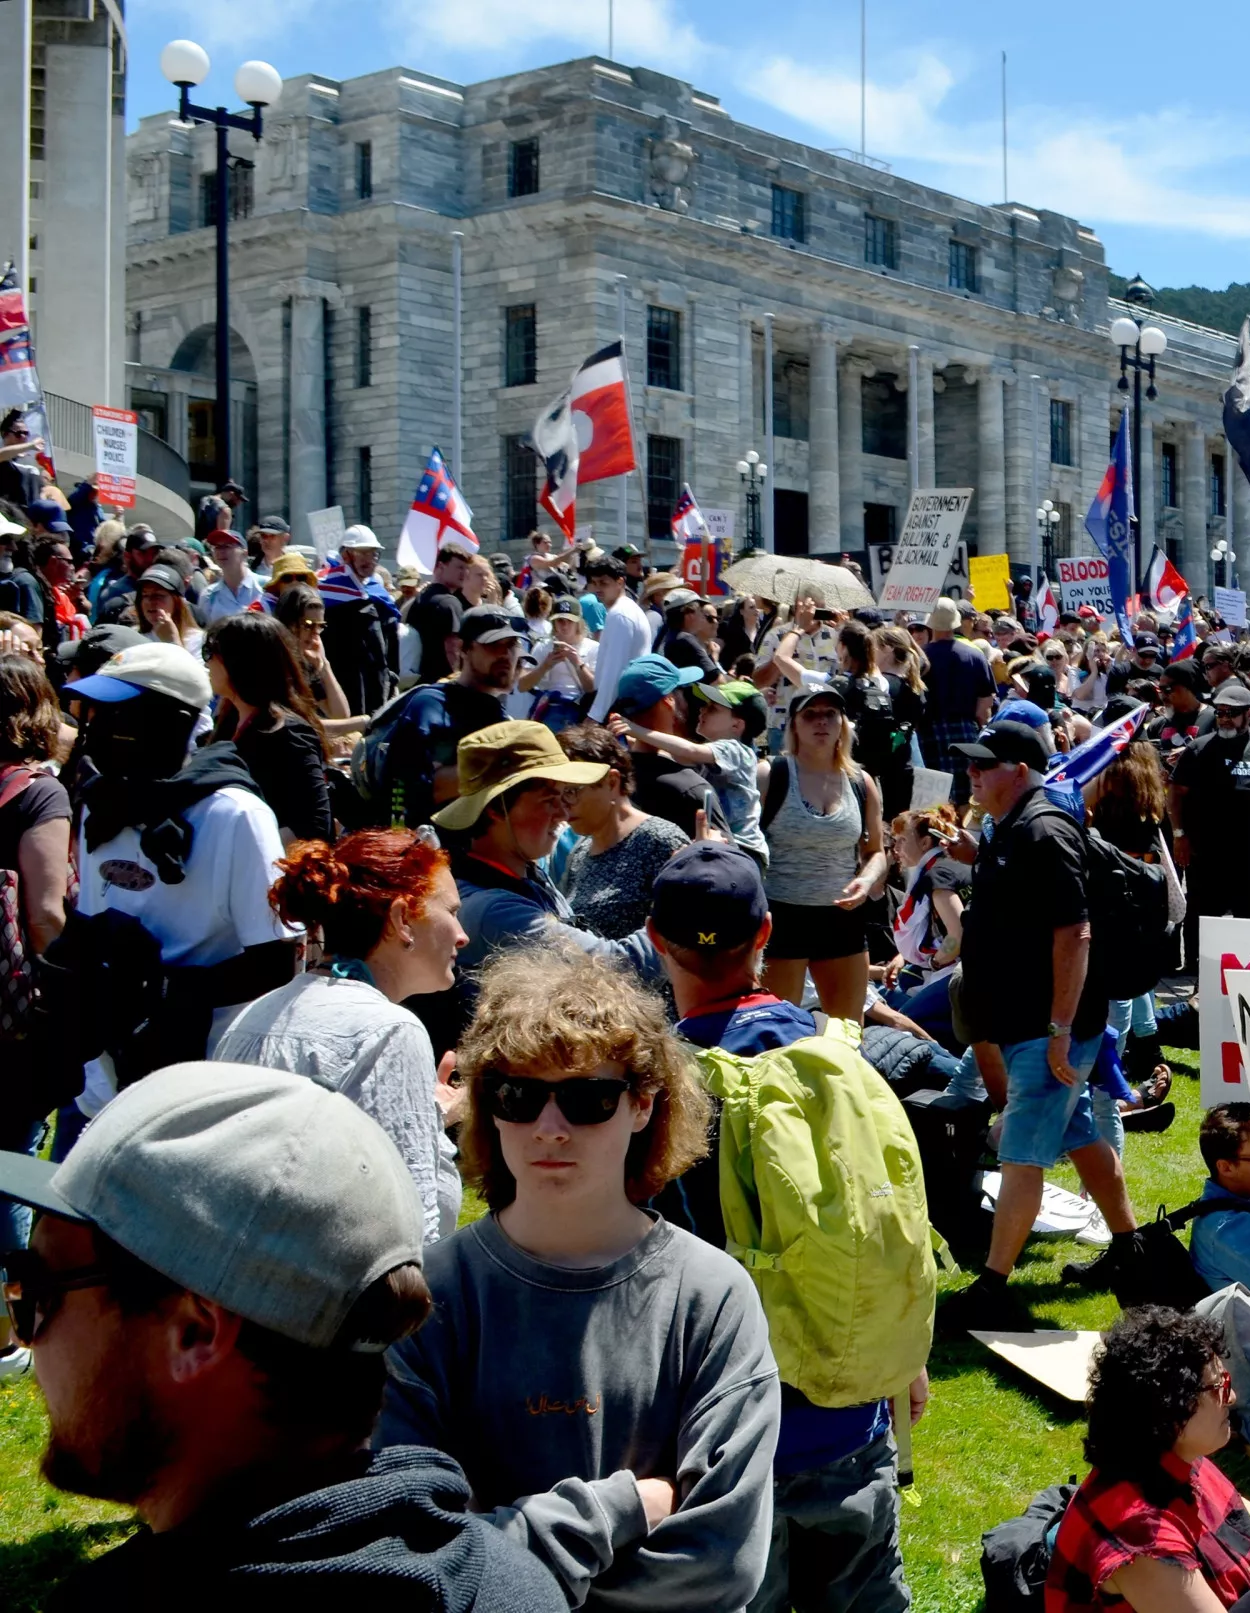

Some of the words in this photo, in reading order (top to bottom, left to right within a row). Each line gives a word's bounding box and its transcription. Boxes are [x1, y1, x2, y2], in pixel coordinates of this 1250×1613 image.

[104, 438, 127, 451] NURSES
[104, 451, 125, 463] POLICE
[912, 496, 969, 512] GOVERNMENT
[907, 514, 941, 529] AGAINST
[901, 532, 940, 547] BULLYING
[942, 533, 952, 548] &
[895, 550, 940, 567] BLACKMAIL
[1059, 560, 1110, 583] BLOOD
[1069, 588, 1084, 598] ON
[697, 932, 717, 945] M
